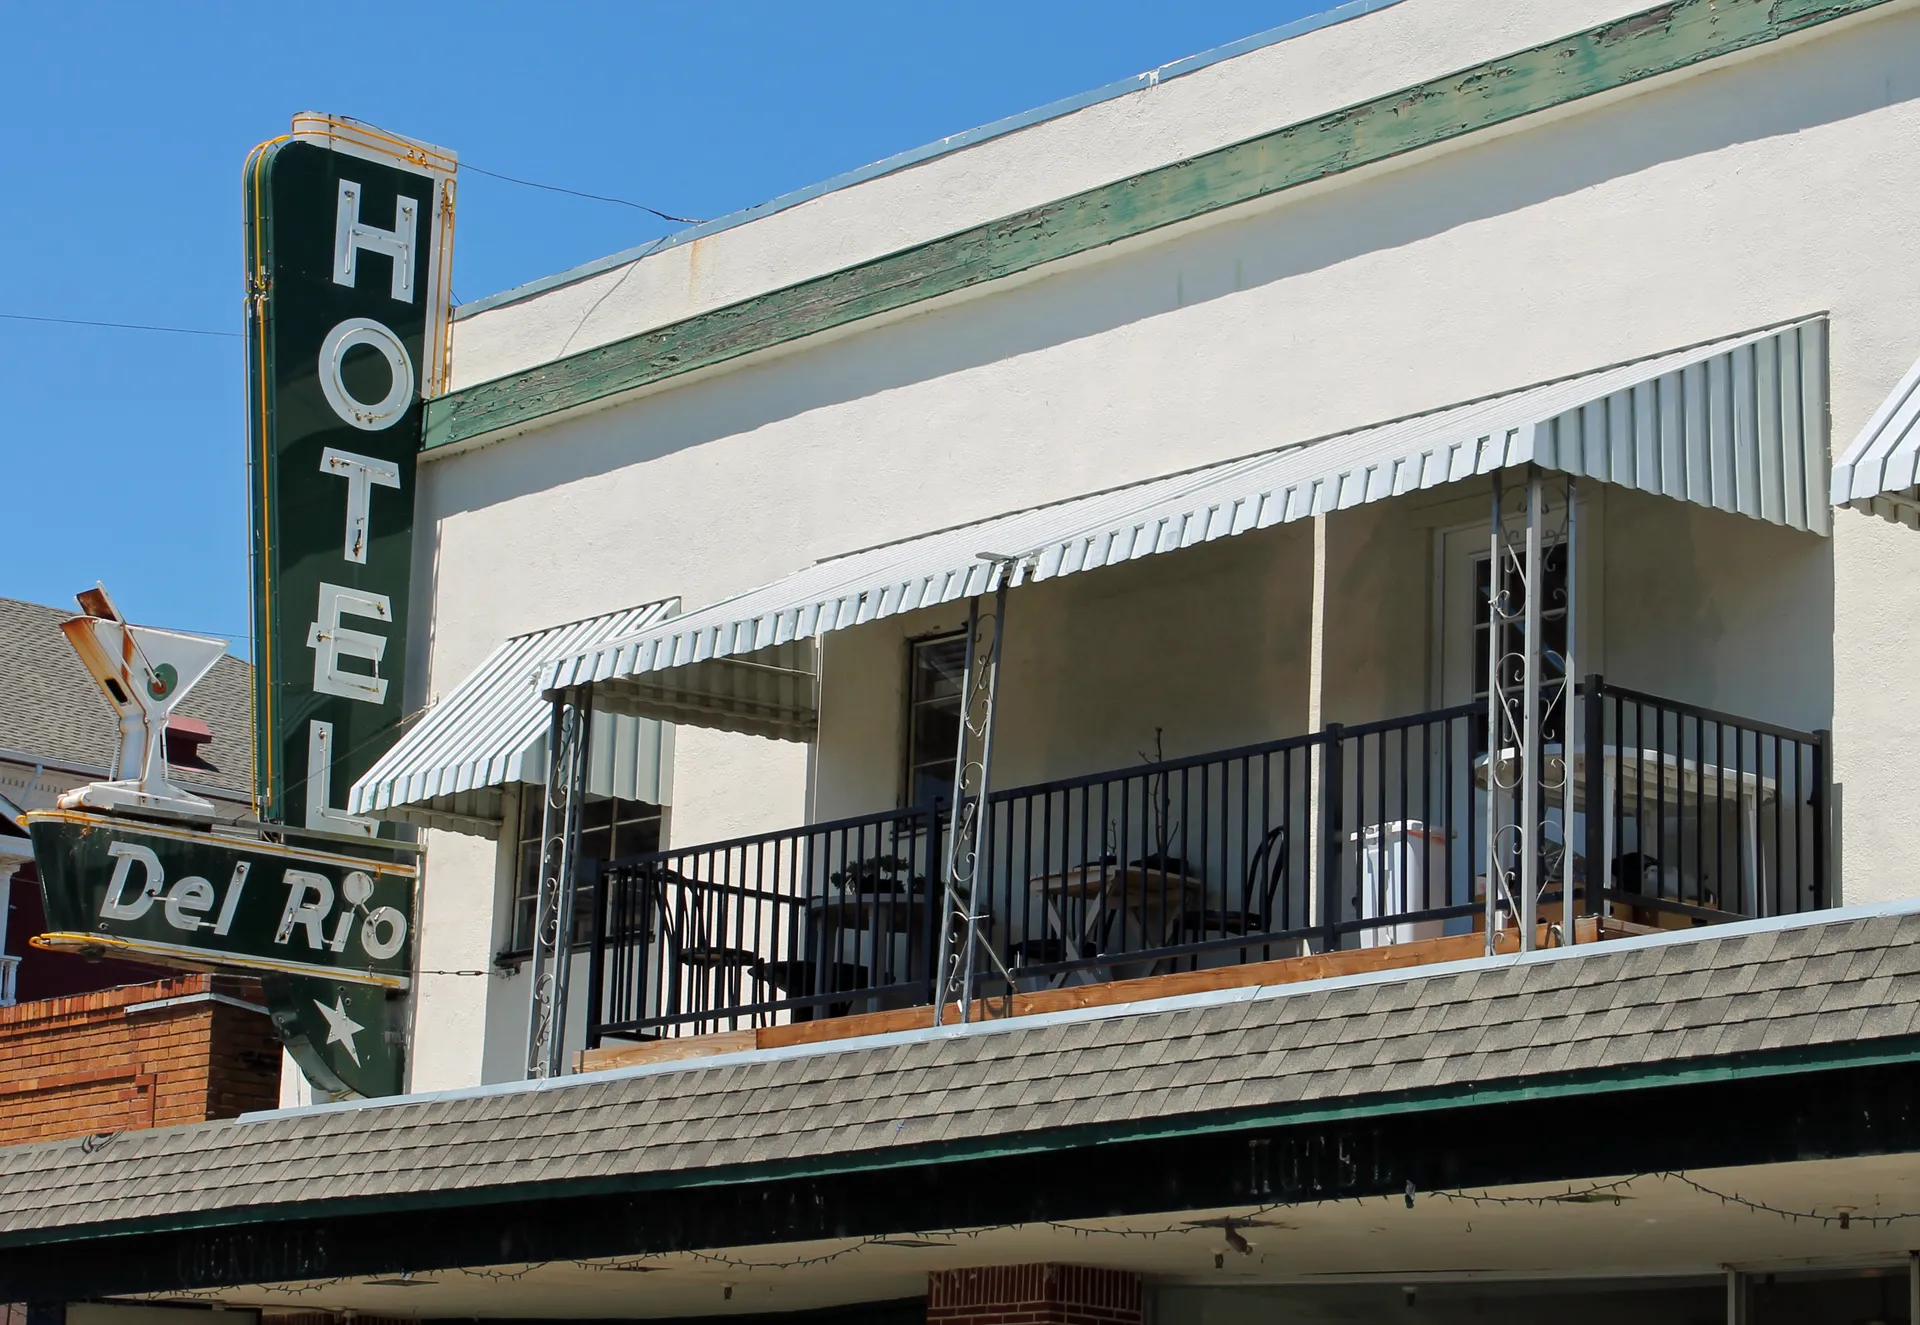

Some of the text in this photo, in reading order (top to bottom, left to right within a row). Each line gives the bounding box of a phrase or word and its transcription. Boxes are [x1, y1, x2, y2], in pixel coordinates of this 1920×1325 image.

[305, 178, 418, 838] HOTEL
[100, 841, 407, 960] Del Rio
